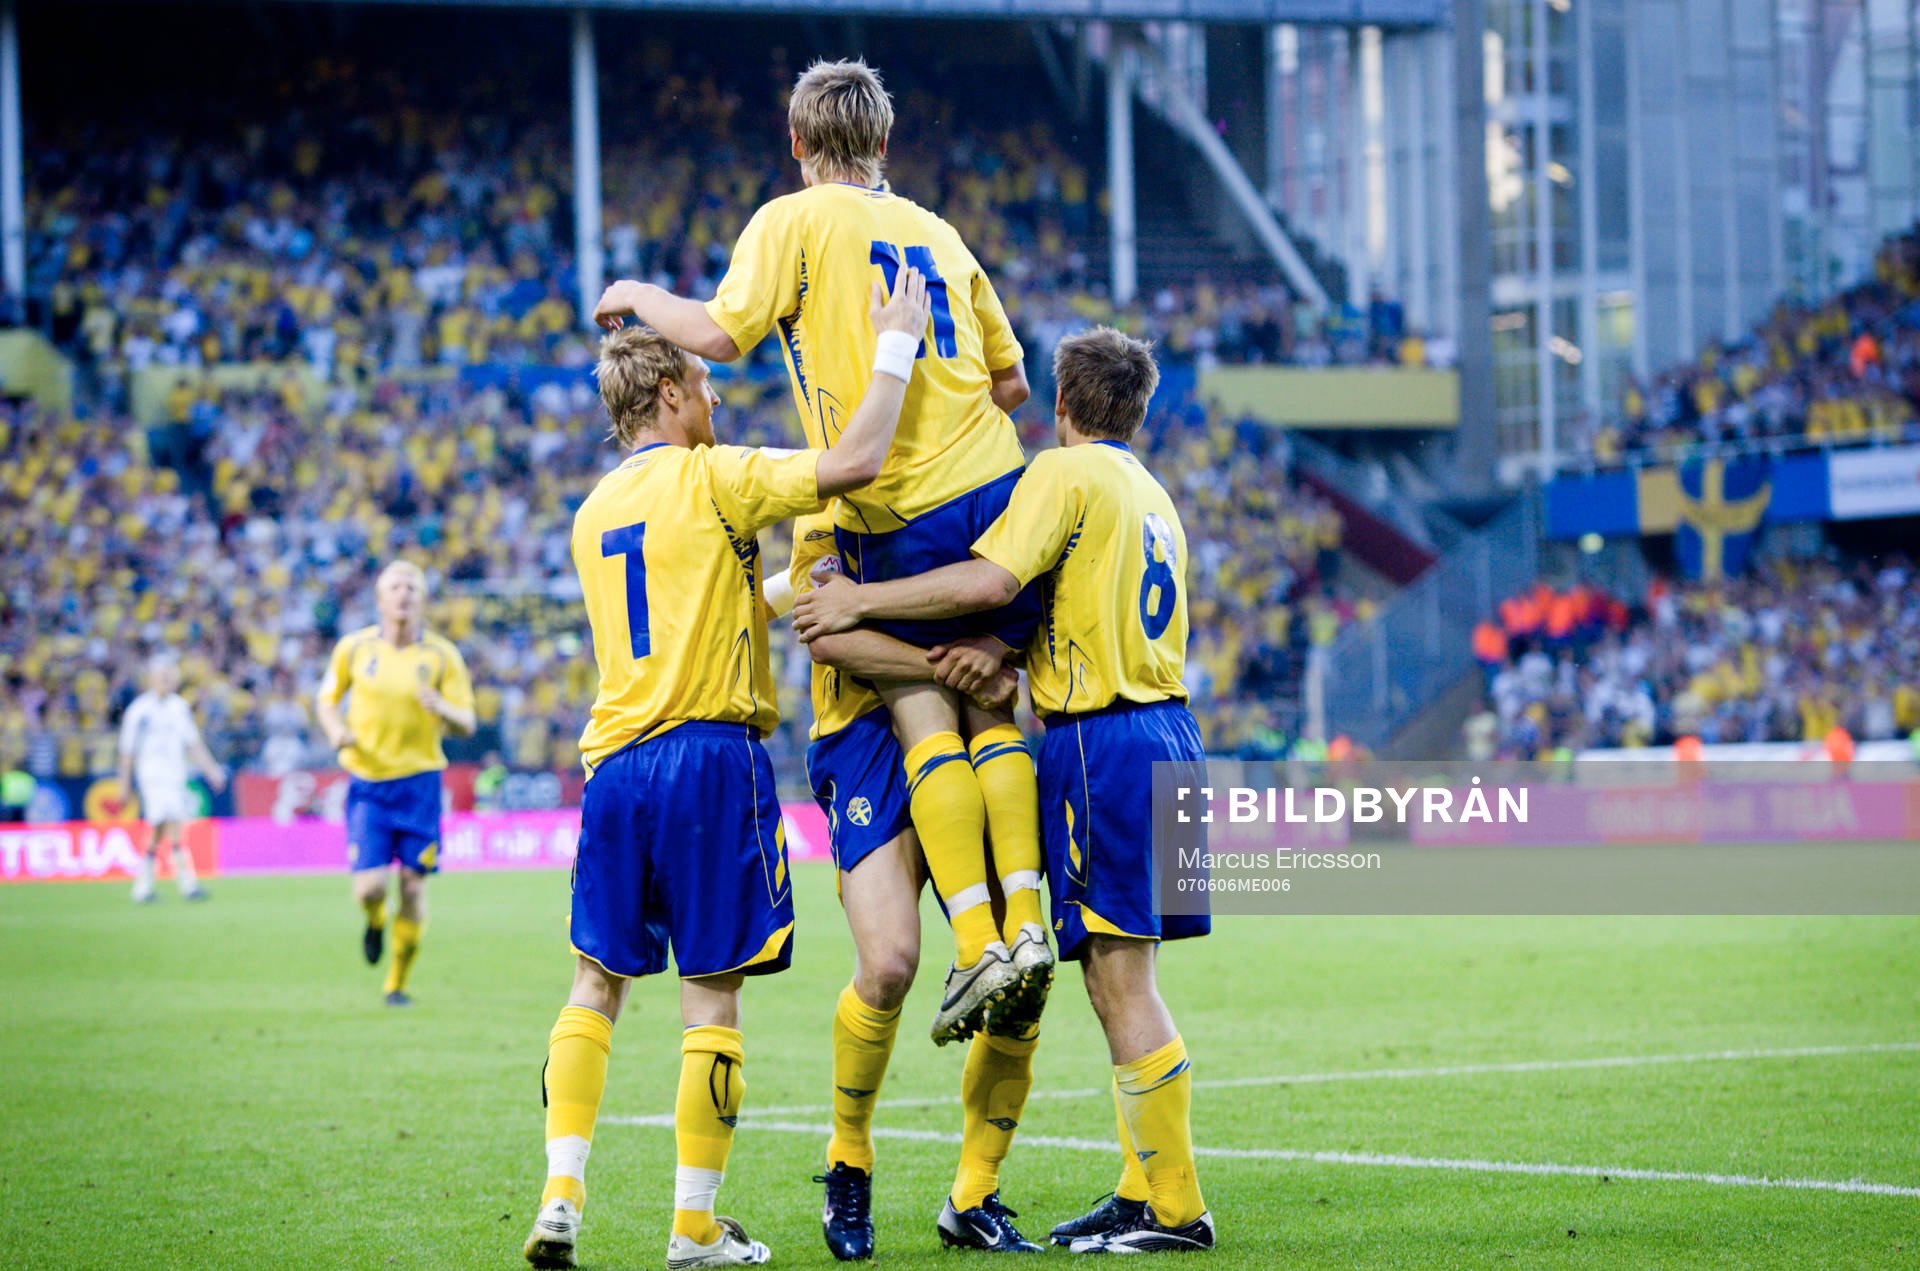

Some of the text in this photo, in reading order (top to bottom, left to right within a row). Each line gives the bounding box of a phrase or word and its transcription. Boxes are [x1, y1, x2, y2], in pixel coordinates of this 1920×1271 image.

[869, 239, 958, 359] 11
[601, 520, 651, 660] 7
[1138, 512, 1177, 640] 8
